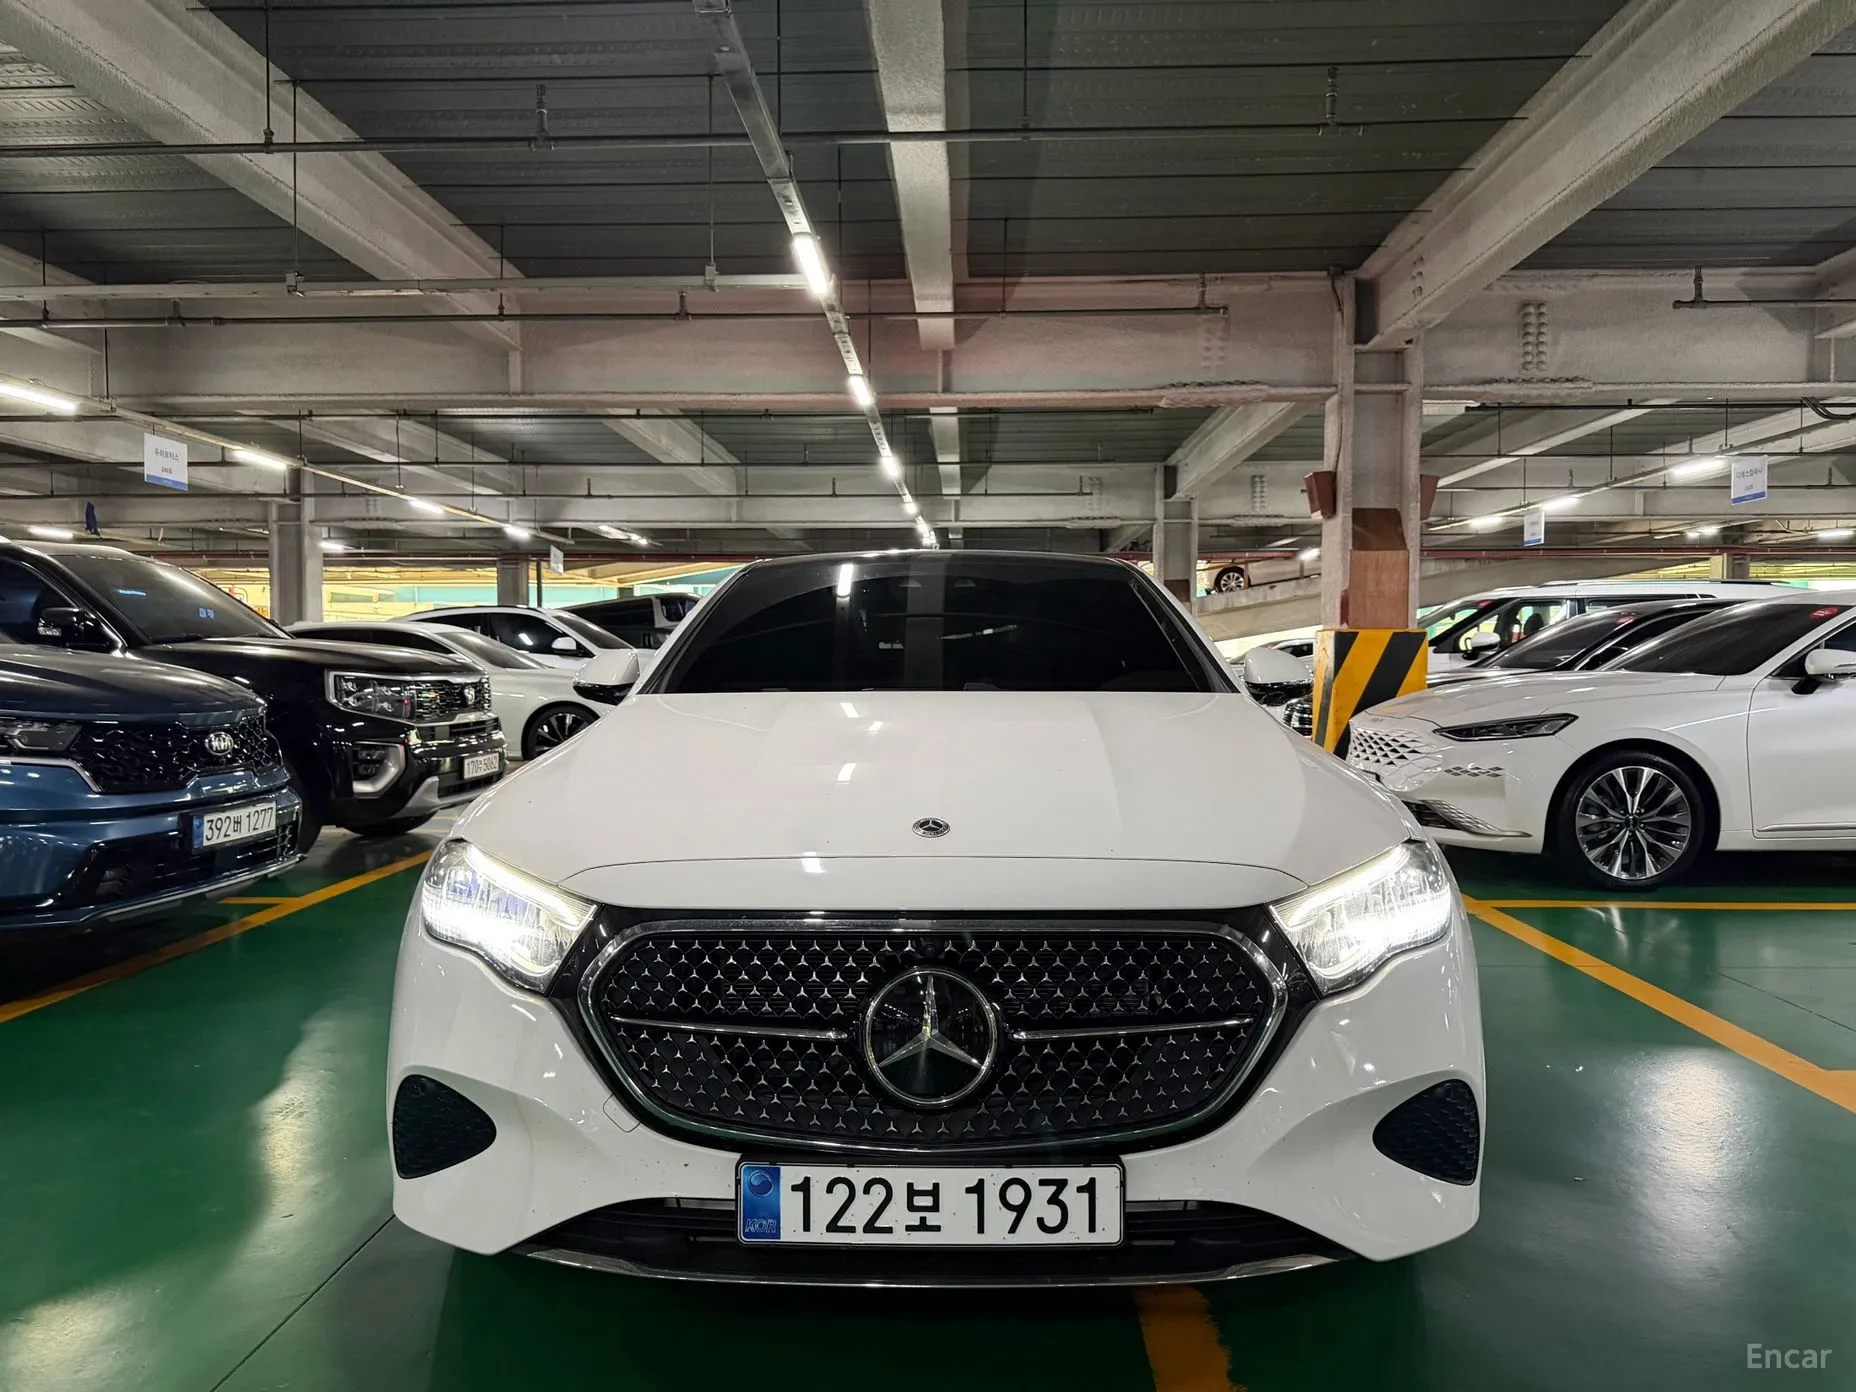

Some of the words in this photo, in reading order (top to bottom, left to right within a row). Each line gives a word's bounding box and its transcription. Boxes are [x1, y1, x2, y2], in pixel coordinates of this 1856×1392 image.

[205, 815, 242, 842] 392버
[246, 806, 274, 833] 1277
[790, 1176, 942, 1234] 122보
[964, 1177, 1097, 1234] 1931
[744, 1218, 777, 1233] KOR
